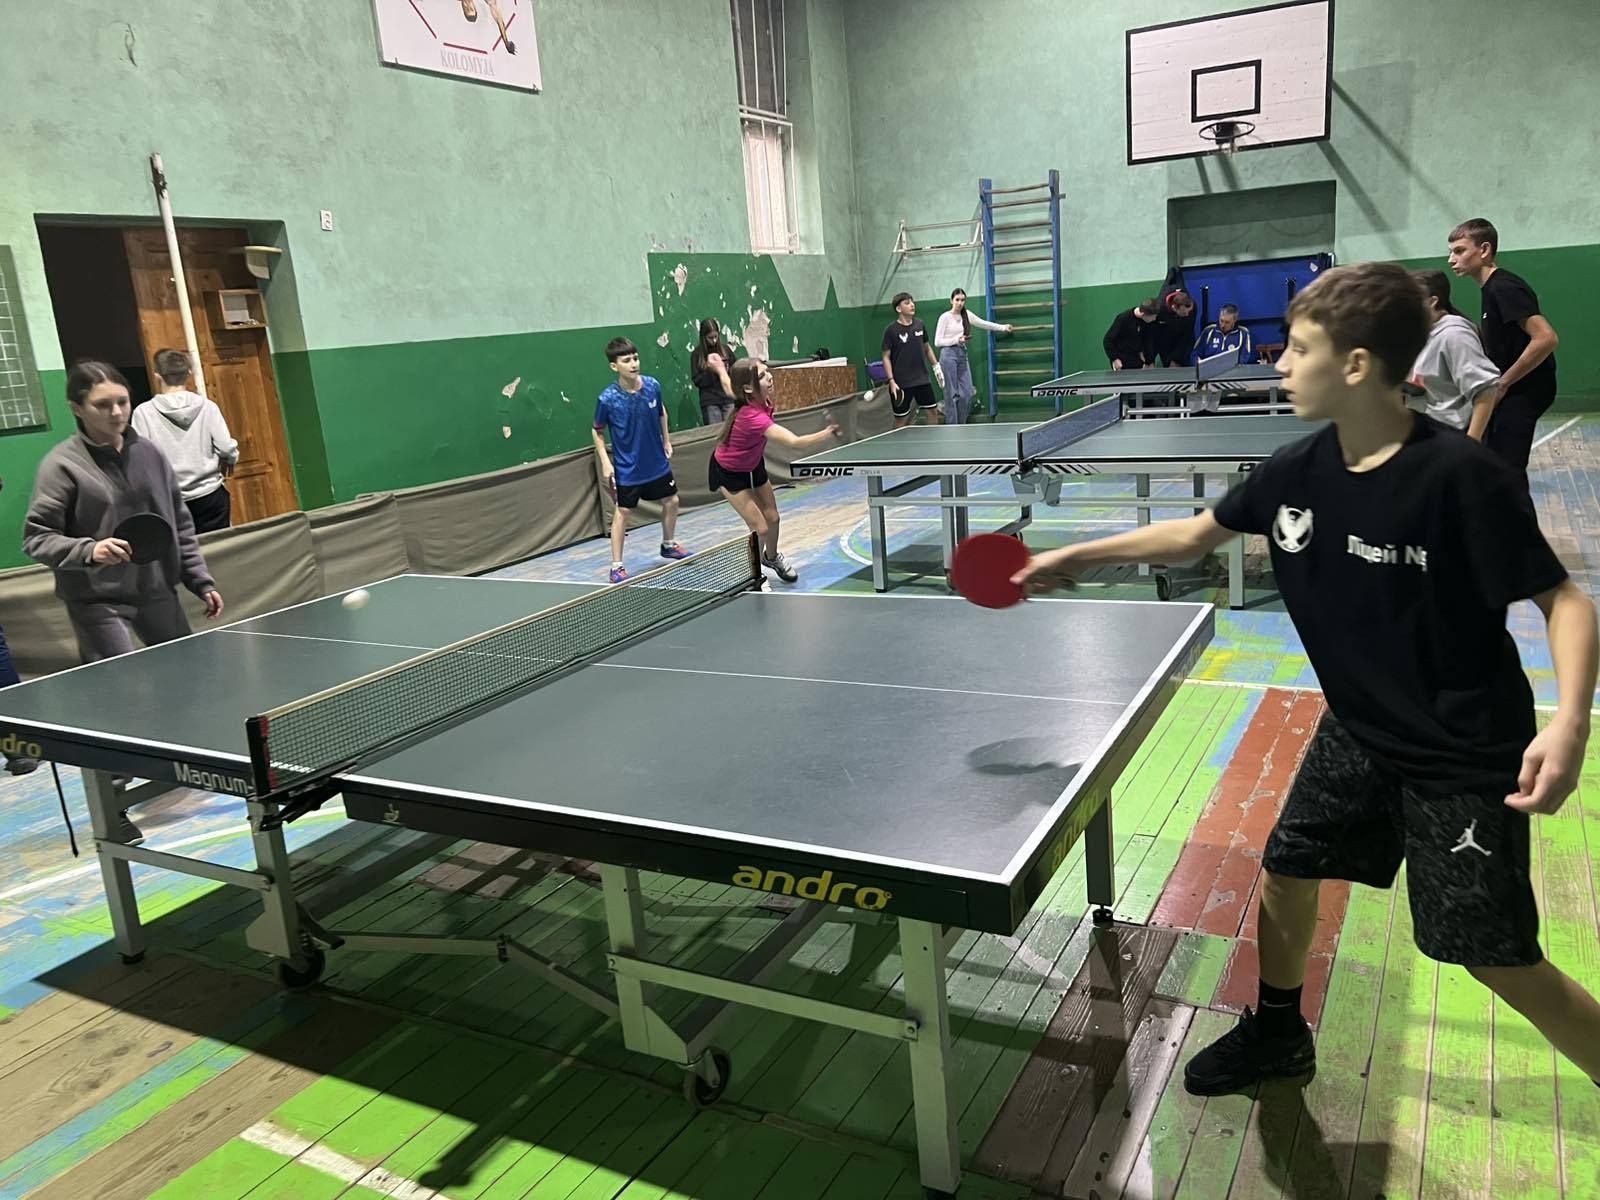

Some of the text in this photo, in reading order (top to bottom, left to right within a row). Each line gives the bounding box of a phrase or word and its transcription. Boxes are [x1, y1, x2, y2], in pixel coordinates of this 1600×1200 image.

[1037, 389, 1079, 397] DONIC
[799, 467, 855, 477] DONIC
[0, 733, 43, 758] dro
[732, 865, 889, 911] andro
